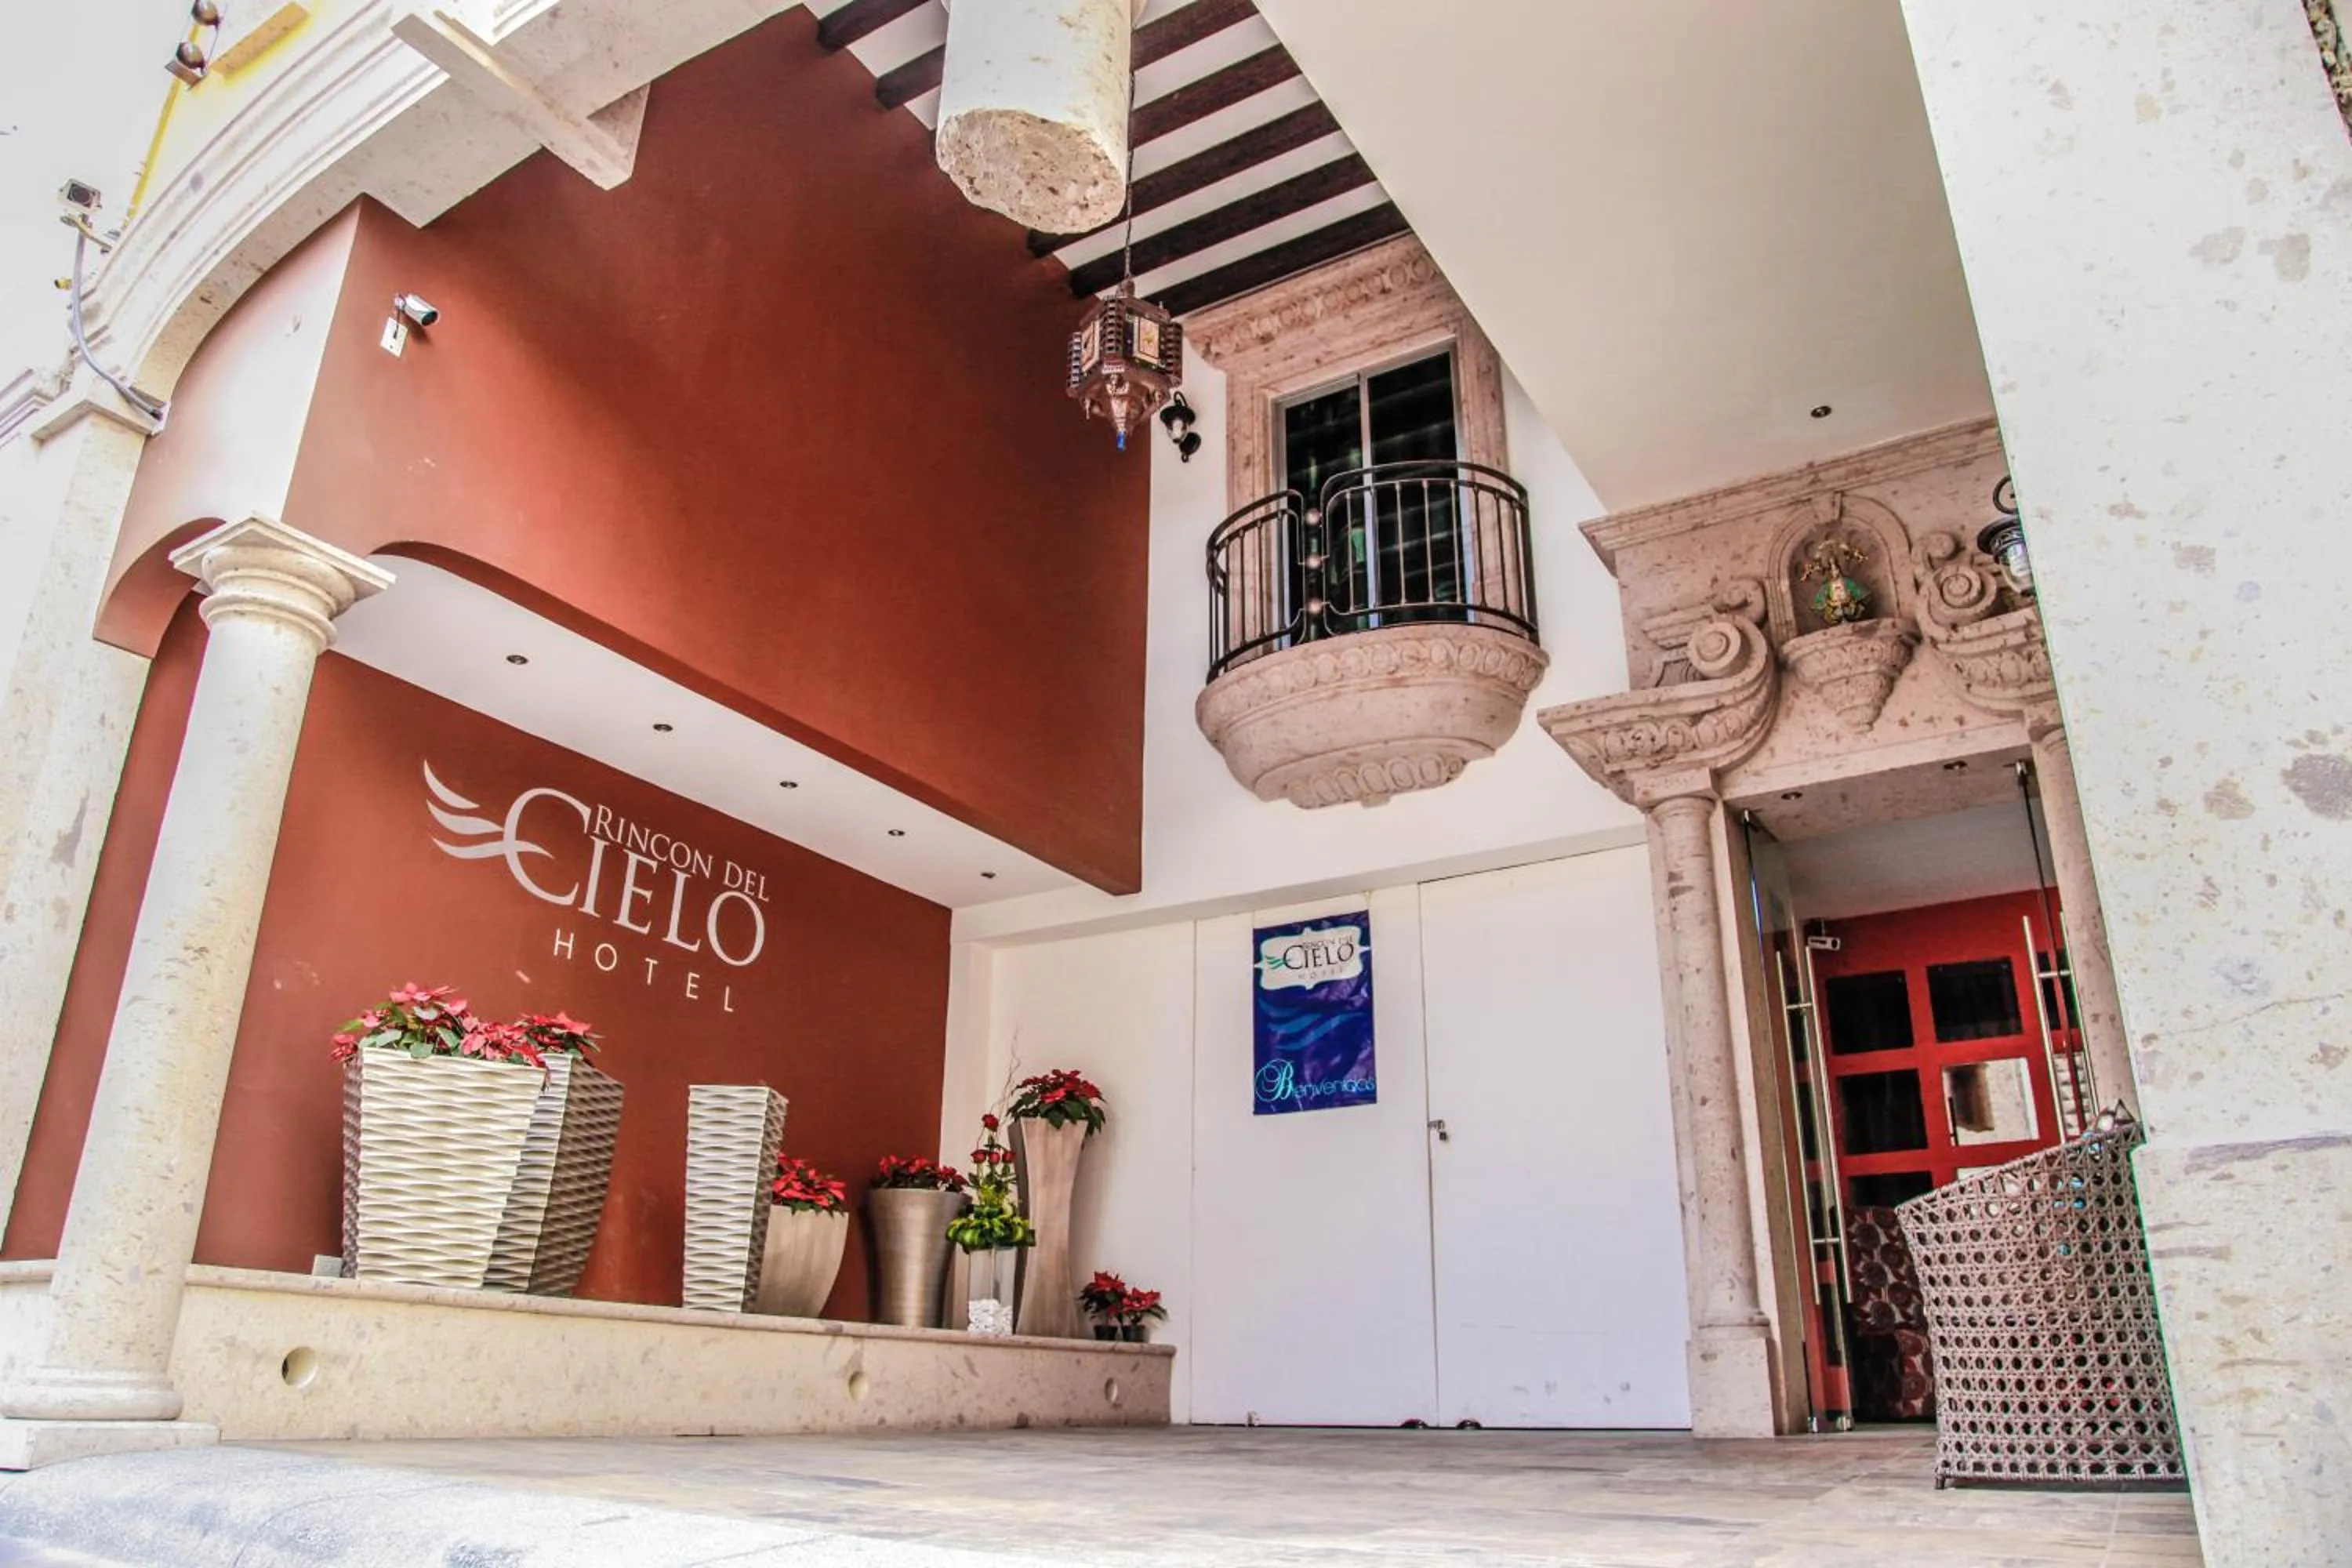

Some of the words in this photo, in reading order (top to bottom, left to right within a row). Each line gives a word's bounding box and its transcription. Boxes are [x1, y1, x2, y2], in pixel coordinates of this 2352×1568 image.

[503, 787, 765, 967] CIELO
[593, 804, 713, 879] RINCON
[723, 861, 770, 902] DEL
[553, 928, 735, 1012] HOTEL
[1283, 943, 1355, 970] CIELO
